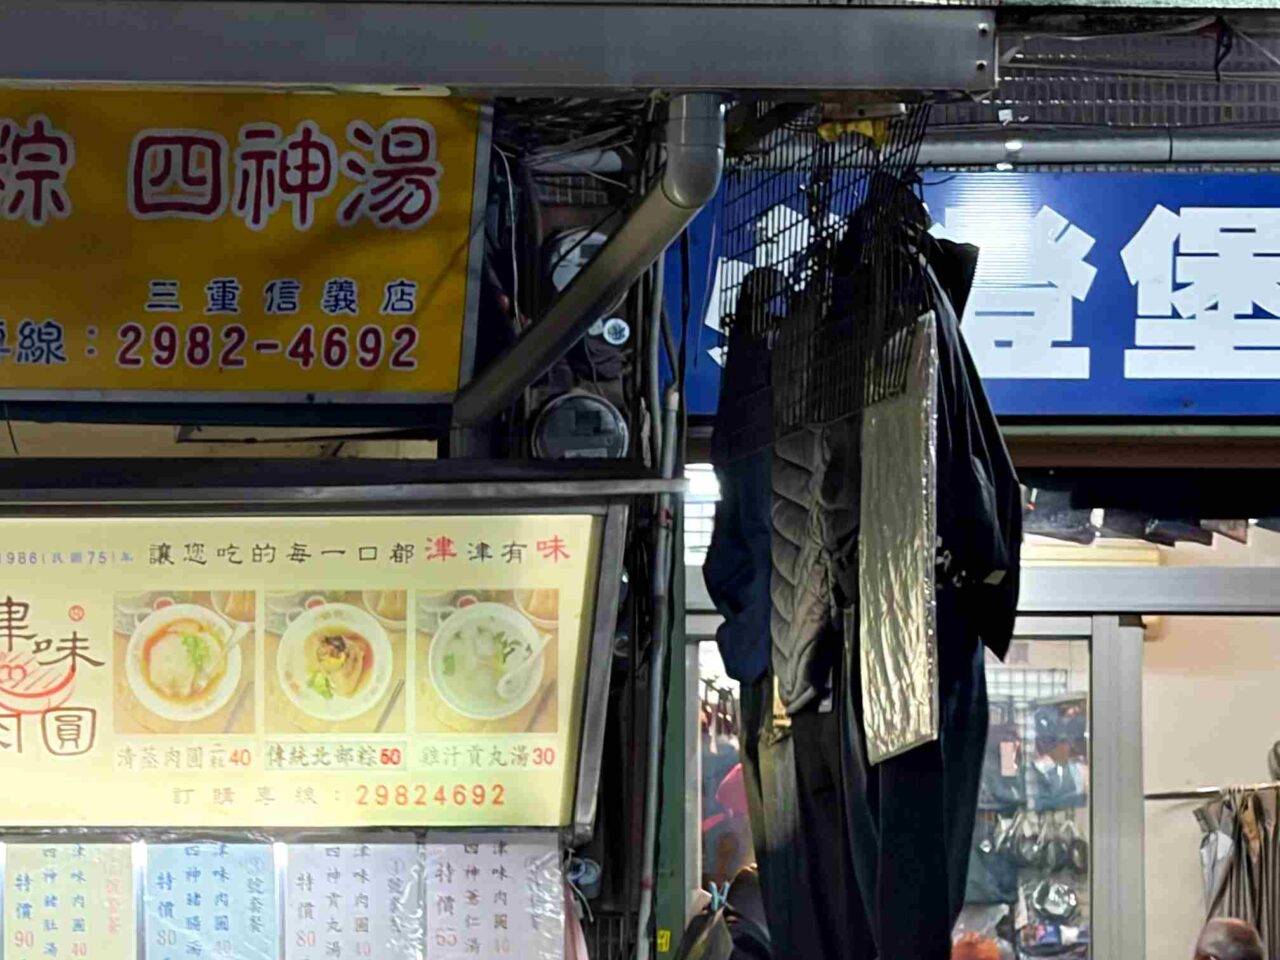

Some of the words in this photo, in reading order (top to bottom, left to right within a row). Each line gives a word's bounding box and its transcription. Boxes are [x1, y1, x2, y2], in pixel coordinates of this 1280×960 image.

[130, 120, 440, 228] 四神湯
[144, 278, 418, 313] 三重信義店
[148, 536, 572, 566] 讓您吃的每一口都津津有味
